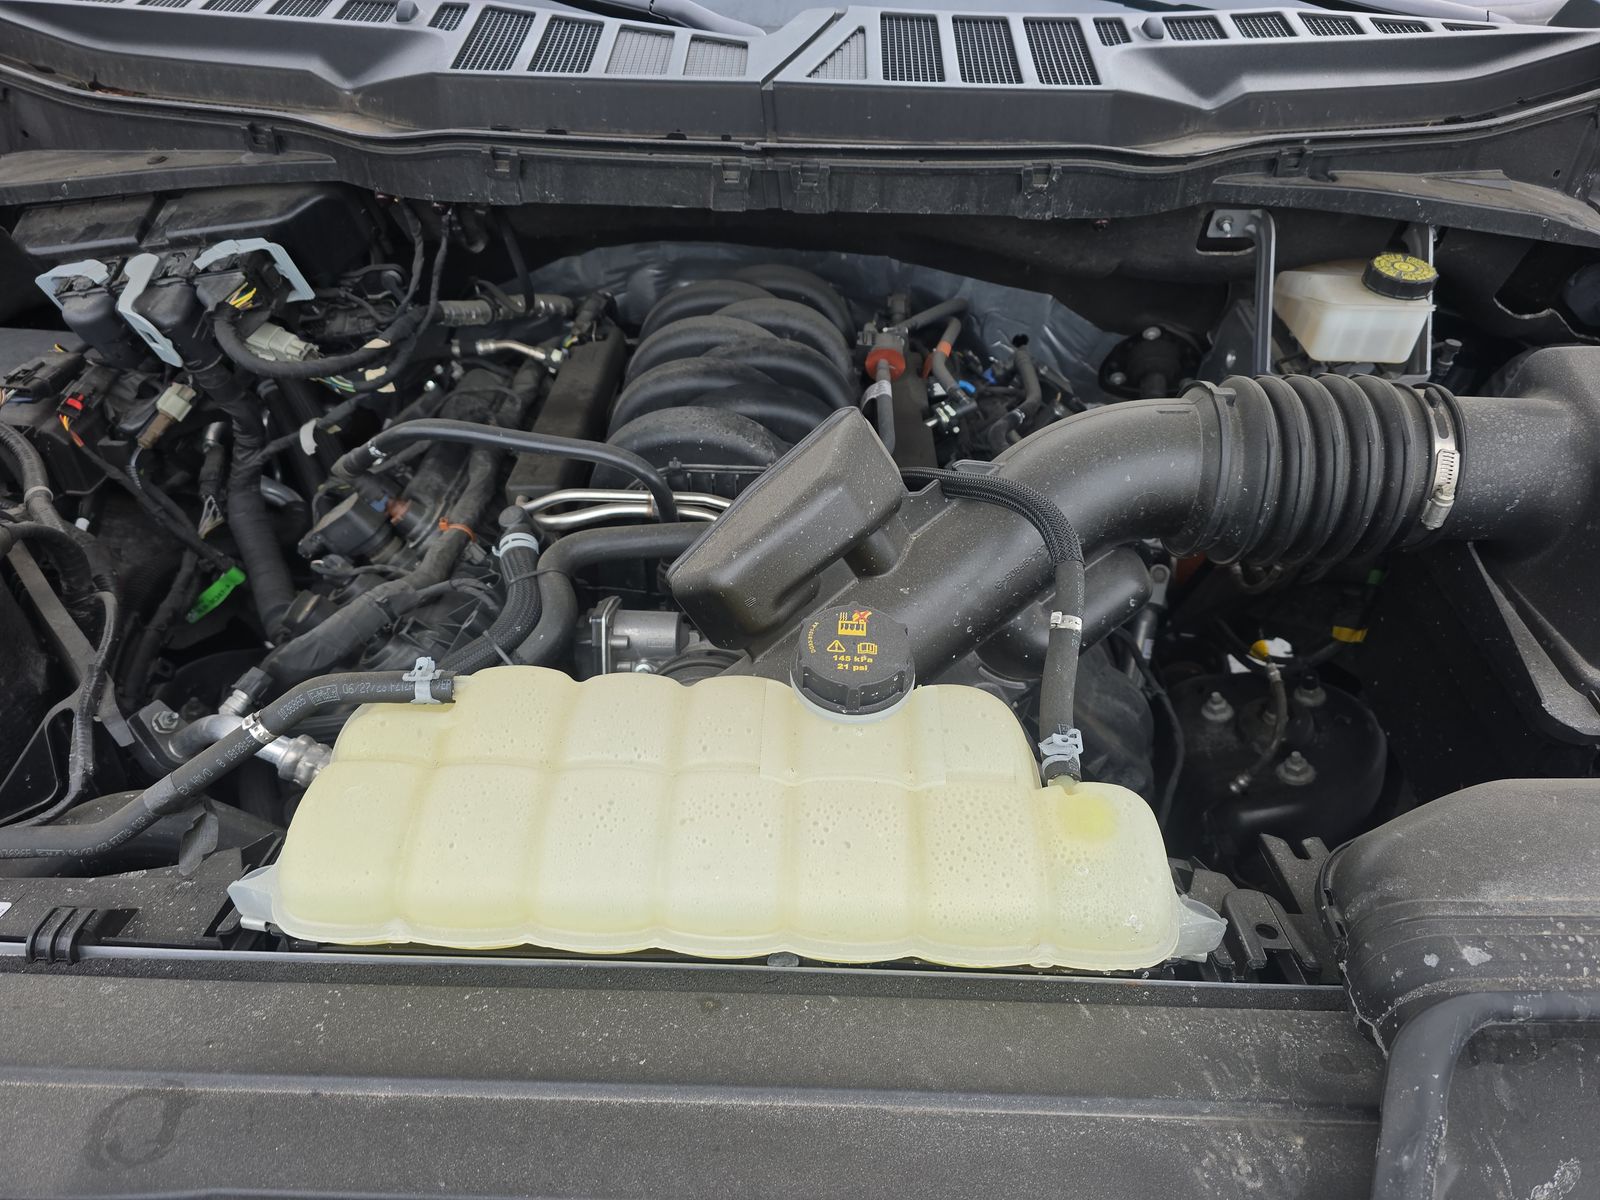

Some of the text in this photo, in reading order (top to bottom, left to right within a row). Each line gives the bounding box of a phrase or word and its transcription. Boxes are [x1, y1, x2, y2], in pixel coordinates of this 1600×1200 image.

[832, 654, 873, 663] 145 kPa
[852, 664, 868, 672] psi
